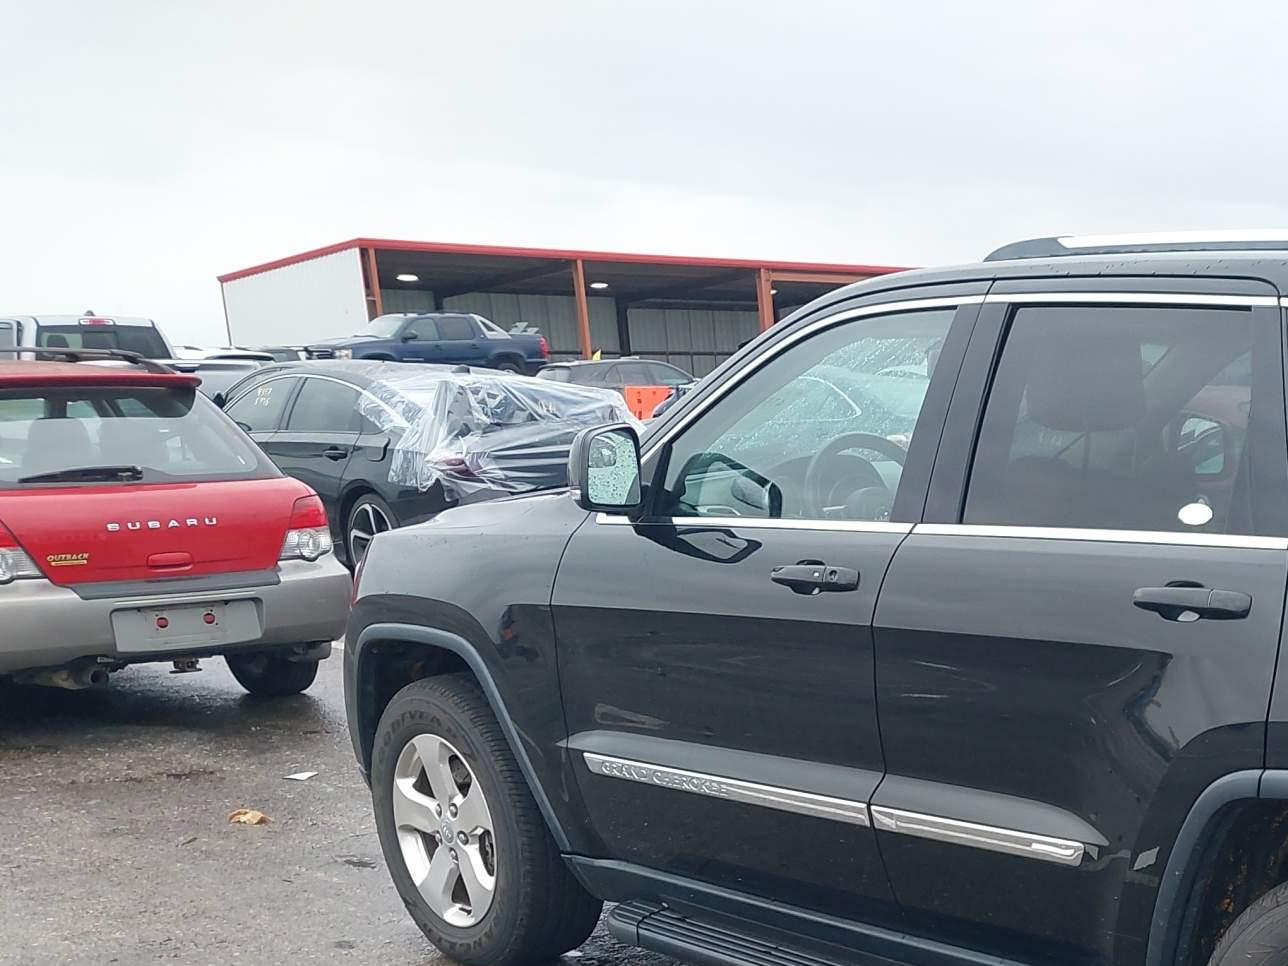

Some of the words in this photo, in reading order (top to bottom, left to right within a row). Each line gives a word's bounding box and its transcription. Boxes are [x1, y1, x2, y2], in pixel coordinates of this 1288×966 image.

[106, 517, 217, 532] SUBARU
[47, 553, 89, 563] OUTBACK
[601, 761, 649, 781] GRAND
[652, 770, 729, 797] CHEROKEE
